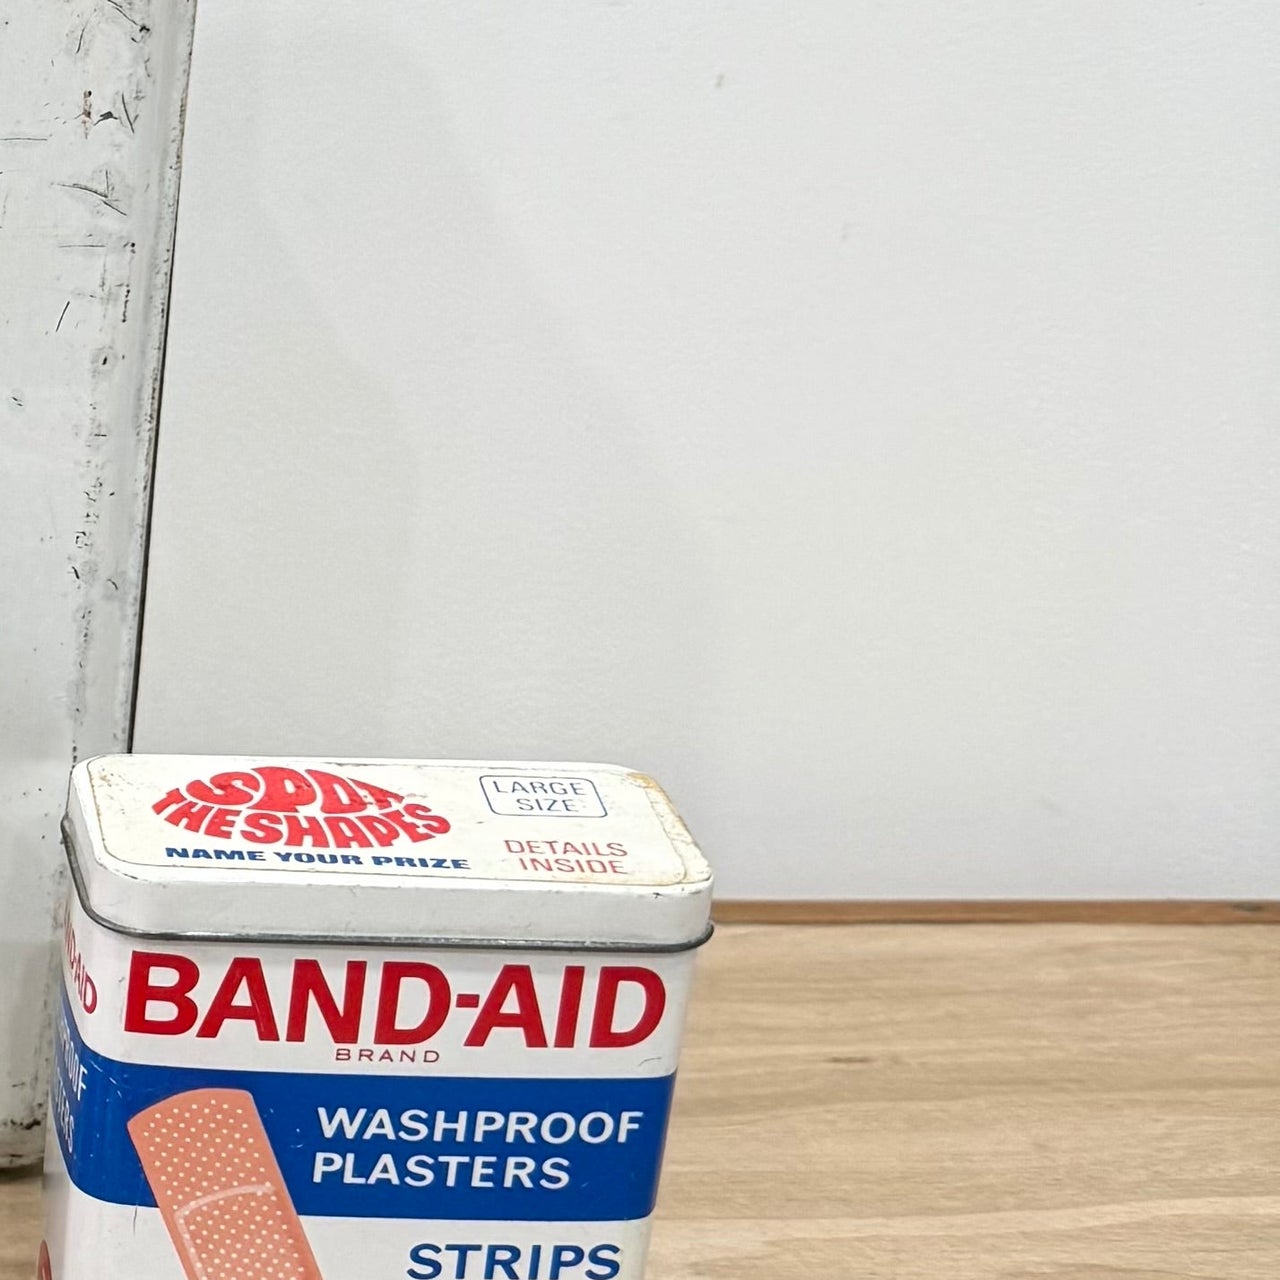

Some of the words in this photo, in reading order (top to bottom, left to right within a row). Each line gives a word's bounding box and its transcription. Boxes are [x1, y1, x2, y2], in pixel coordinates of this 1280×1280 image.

[186, 766, 405, 814] SPOT
[492, 779, 586, 797] LARGE
[514, 796, 579, 813] SIZE
[151, 787, 243, 839] THE
[239, 803, 452, 848] SHAPES
[165, 847, 268, 862] NAME
[273, 851, 364, 866] YOUR
[371, 855, 472, 870] PRIZE
[504, 837, 628, 857] DETAILS
[519, 856, 628, 875] INSIDE
[124, 950, 666, 1050] BAND-AID
[335, 1048, 441, 1064] BRAND
[316, 1106, 644, 1145] WASHPROOF
[312, 1152, 572, 1190] PLASTERS
